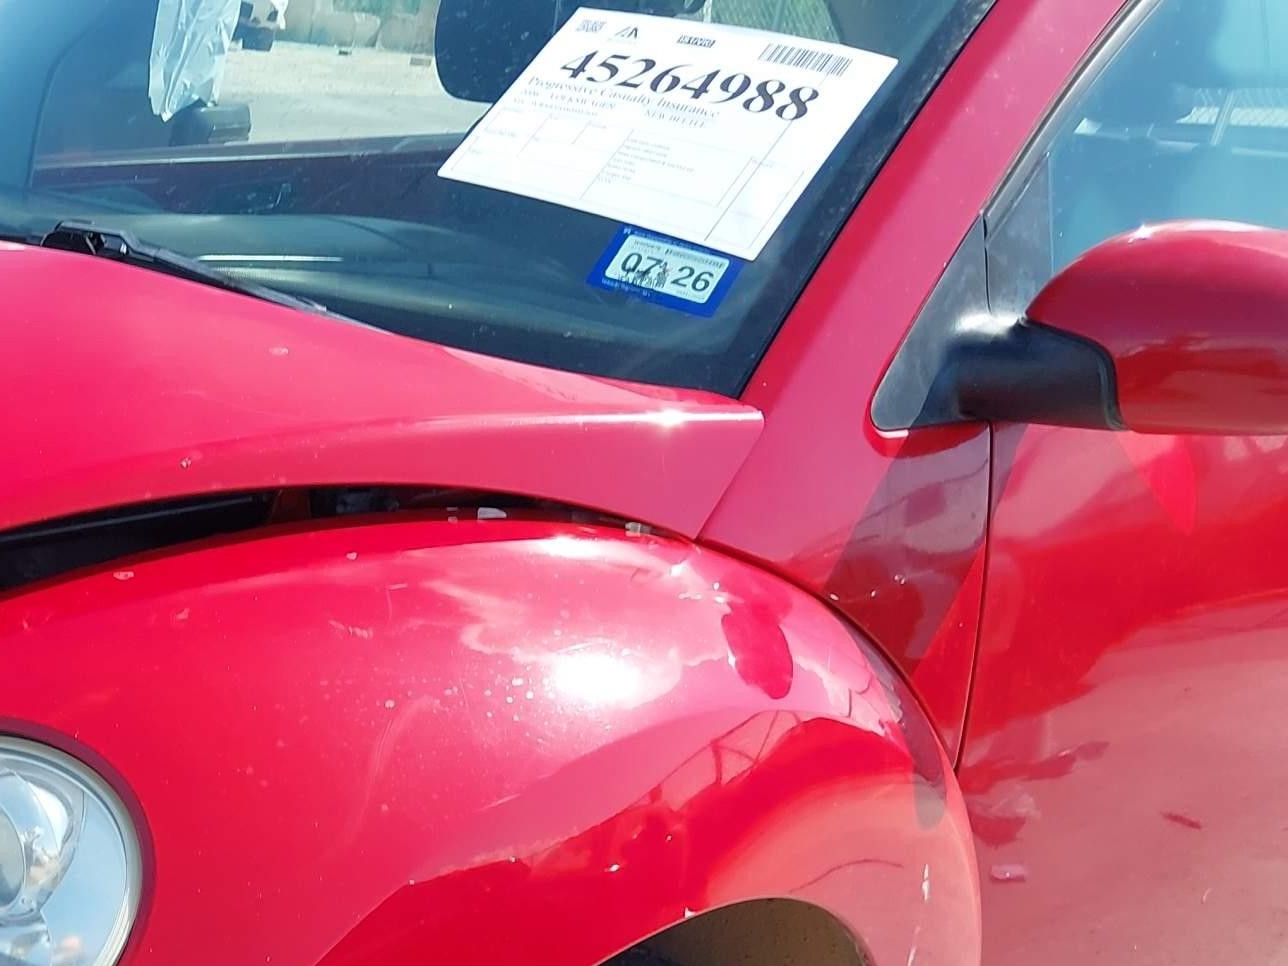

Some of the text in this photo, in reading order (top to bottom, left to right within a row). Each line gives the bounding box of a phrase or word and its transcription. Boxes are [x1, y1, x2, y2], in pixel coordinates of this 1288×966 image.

[527, 75, 598, 96] Progressive
[600, 87, 653, 106] Casualty
[656, 97, 720, 119] Insurance
[560, 49, 820, 122] 45264988
[621, 252, 663, 276] 07
[671, 265, 714, 292] 26
